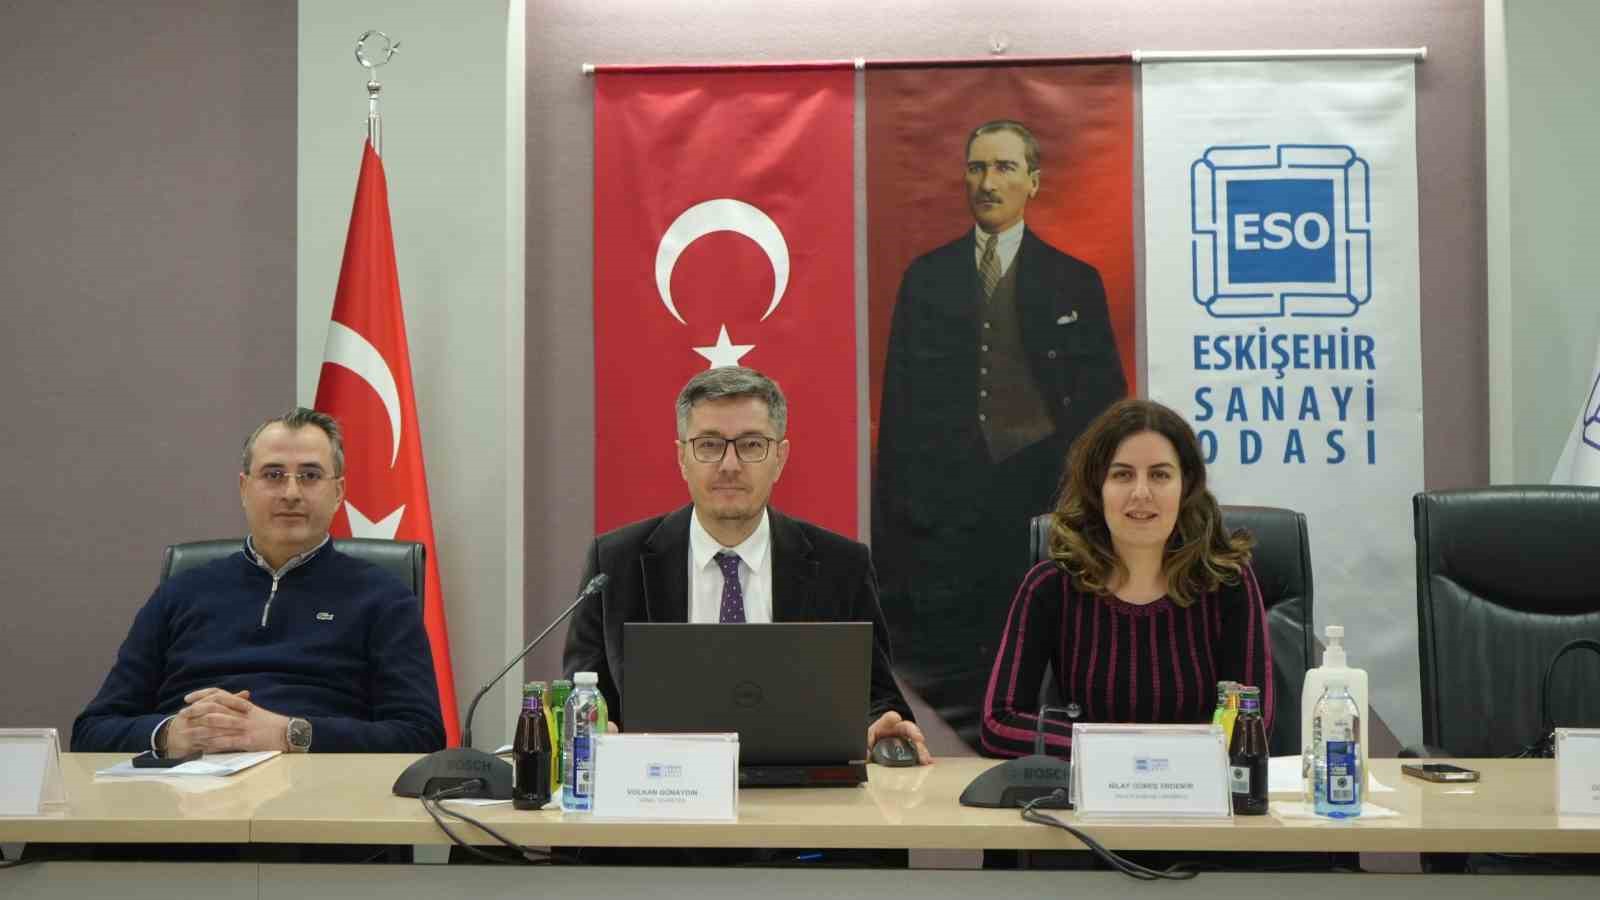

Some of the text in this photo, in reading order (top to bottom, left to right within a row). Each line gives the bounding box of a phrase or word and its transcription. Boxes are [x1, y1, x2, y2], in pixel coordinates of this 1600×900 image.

[1233, 212, 1331, 251] ESO
[1193, 326, 1377, 379] ESKİŞEHİR
[1194, 379, 1376, 423] SANAYİ
[626, 788, 658, 796] VOLKAN
